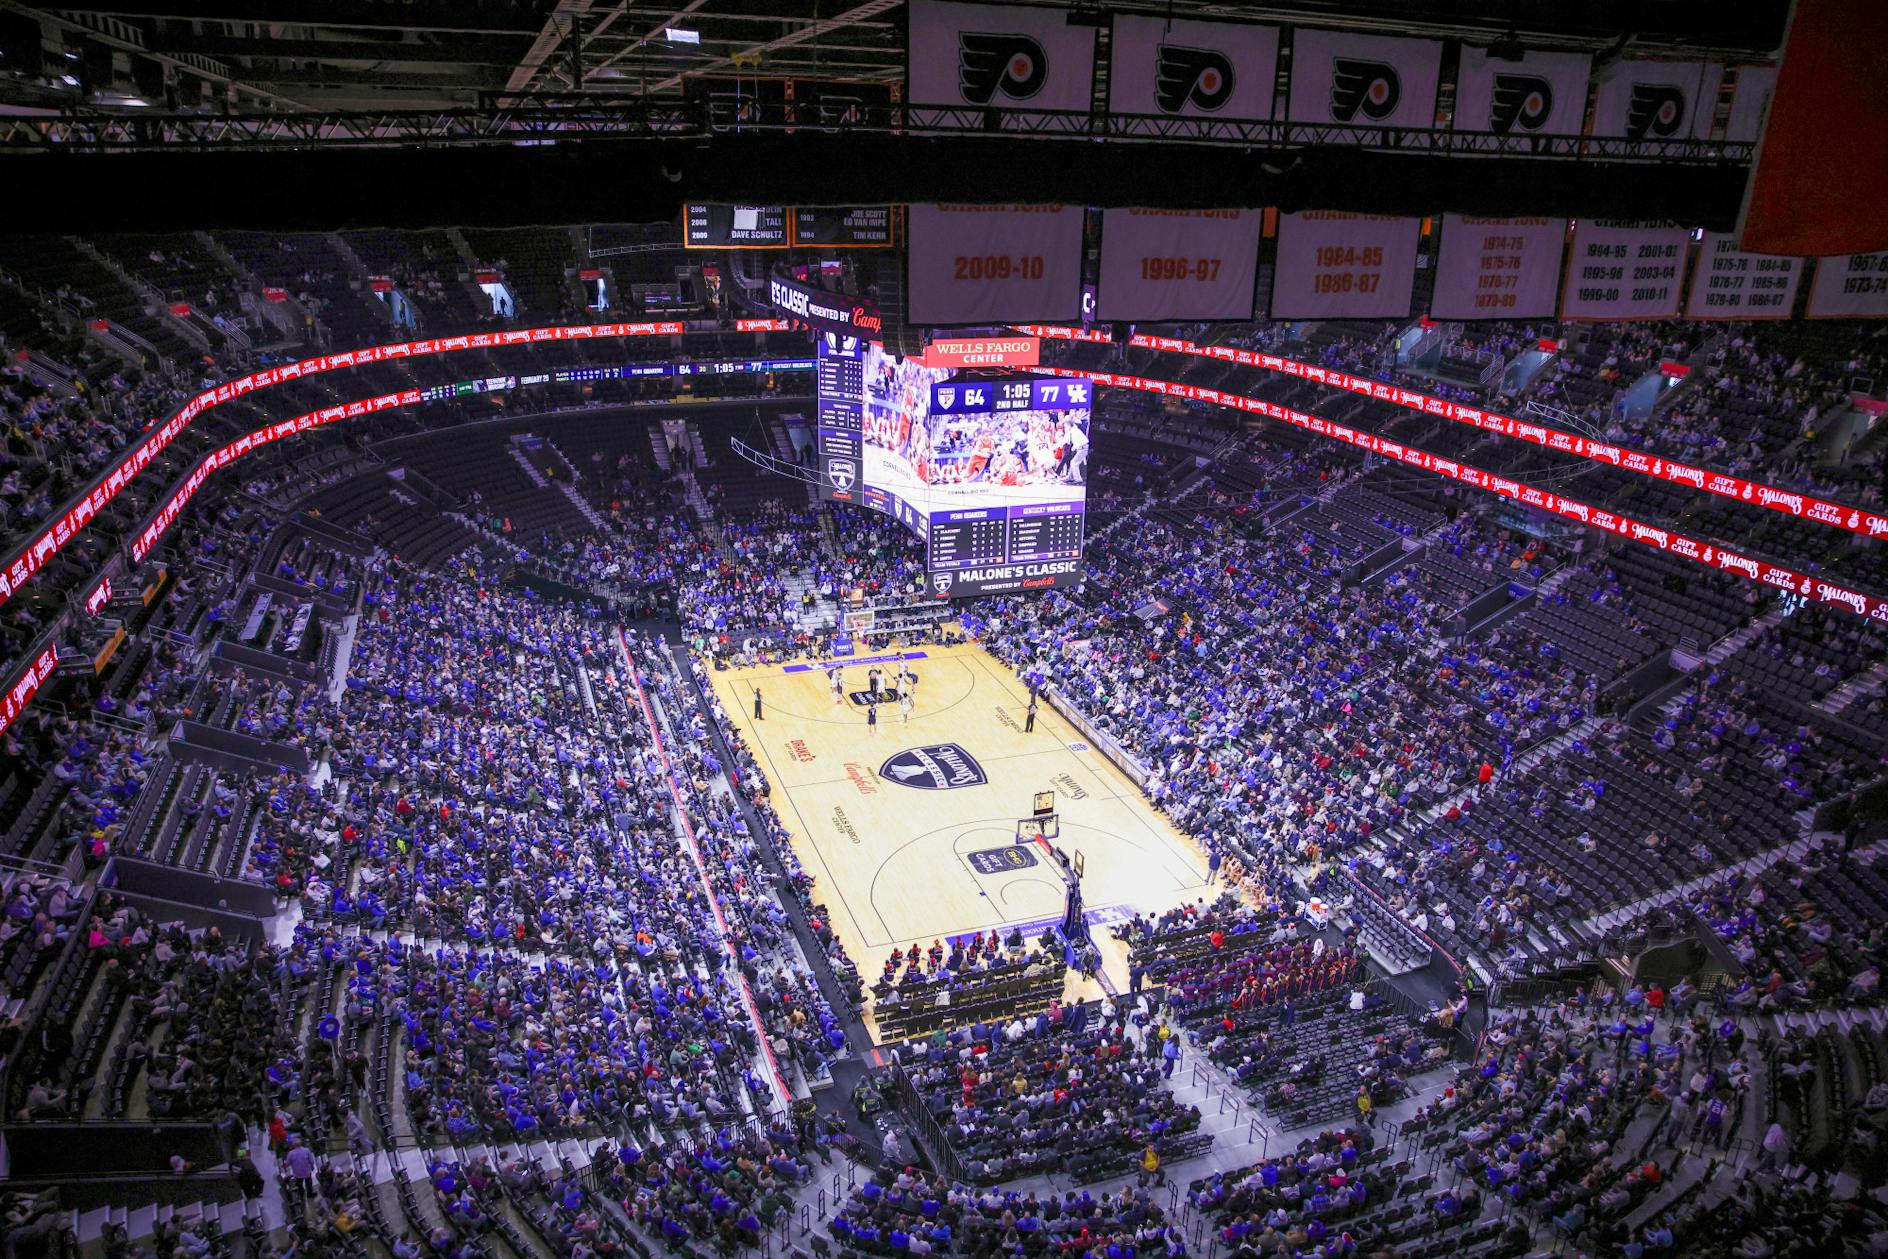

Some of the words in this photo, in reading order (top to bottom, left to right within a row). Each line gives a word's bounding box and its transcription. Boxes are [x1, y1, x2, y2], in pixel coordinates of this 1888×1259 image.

[854, 218, 868, 226] VAN
[732, 231, 749, 239] DAVE
[751, 231, 782, 239] SCHULTZ
[1316, 247, 1383, 267] 1984-85
[954, 257, 1044, 280] 2009-10
[1140, 257, 1221, 281] 1996-97
[1713, 258, 1747, 270] 1975-76
[1314, 273, 1380, 293] 1986-87
[1709, 277, 1744, 288] 1976-77
[781, 286, 809, 318] CLASSIC
[809, 303, 839, 320] PRESENTED
[840, 311, 850, 322] BY
[937, 344, 982, 353] WELLS
[987, 342, 1030, 352] FARGO
[964, 354, 1003, 363] CENTER
[679, 364, 691, 374] 64
[714, 363, 734, 373] 1:05
[751, 362, 762, 371] 77
[521, 375, 542, 384] FEBRUARY
[965, 389, 985, 405] 64
[1003, 384, 1030, 399] 1:05
[1041, 387, 1059, 402] 77
[997, 401, 1010, 409] 2ND
[1013, 400, 1028, 408] HALF
[1487, 416, 1502, 424] GIFT
[1484, 421, 1504, 431] CARDS
[1554, 434, 1570, 442] GIFT
[1549, 439, 1571, 449] CARDS
[1628, 453, 1647, 463] GIFT
[1623, 460, 1649, 471] CARDS
[1464, 468, 1477, 476] GIFT
[1460, 474, 1479, 484] CARDS
[1714, 477, 1735, 486] GIFT
[1526, 489, 1541, 498] GIFT
[1708, 484, 1737, 496] CARDS
[1522, 495, 1542, 506] CARDS
[1814, 503, 1839, 514] GIFT
[1596, 512, 1614, 522] GIFT
[1807, 509, 1842, 524] CARDS
[1591, 517, 1616, 530] CARDS
[1676, 538, 1696, 549] GIFT
[1671, 544, 1699, 558] CARDS
[959, 566, 1024, 582] MALONE'S
[1026, 561, 1076, 576] CLASSIC
[1769, 568, 1792, 580] GIFT
[981, 583, 1012, 591] PRESENTED
[1763, 574, 1795, 589] CARDS
[790, 740, 816, 762] DRAKE'S
[929, 747, 978, 784] MALONE'S
[834, 806, 848, 825] WELLS
[846, 824, 860, 844] FARGO
[976, 853, 995, 872] CARDS
[989, 854, 1003, 867] GIFT
